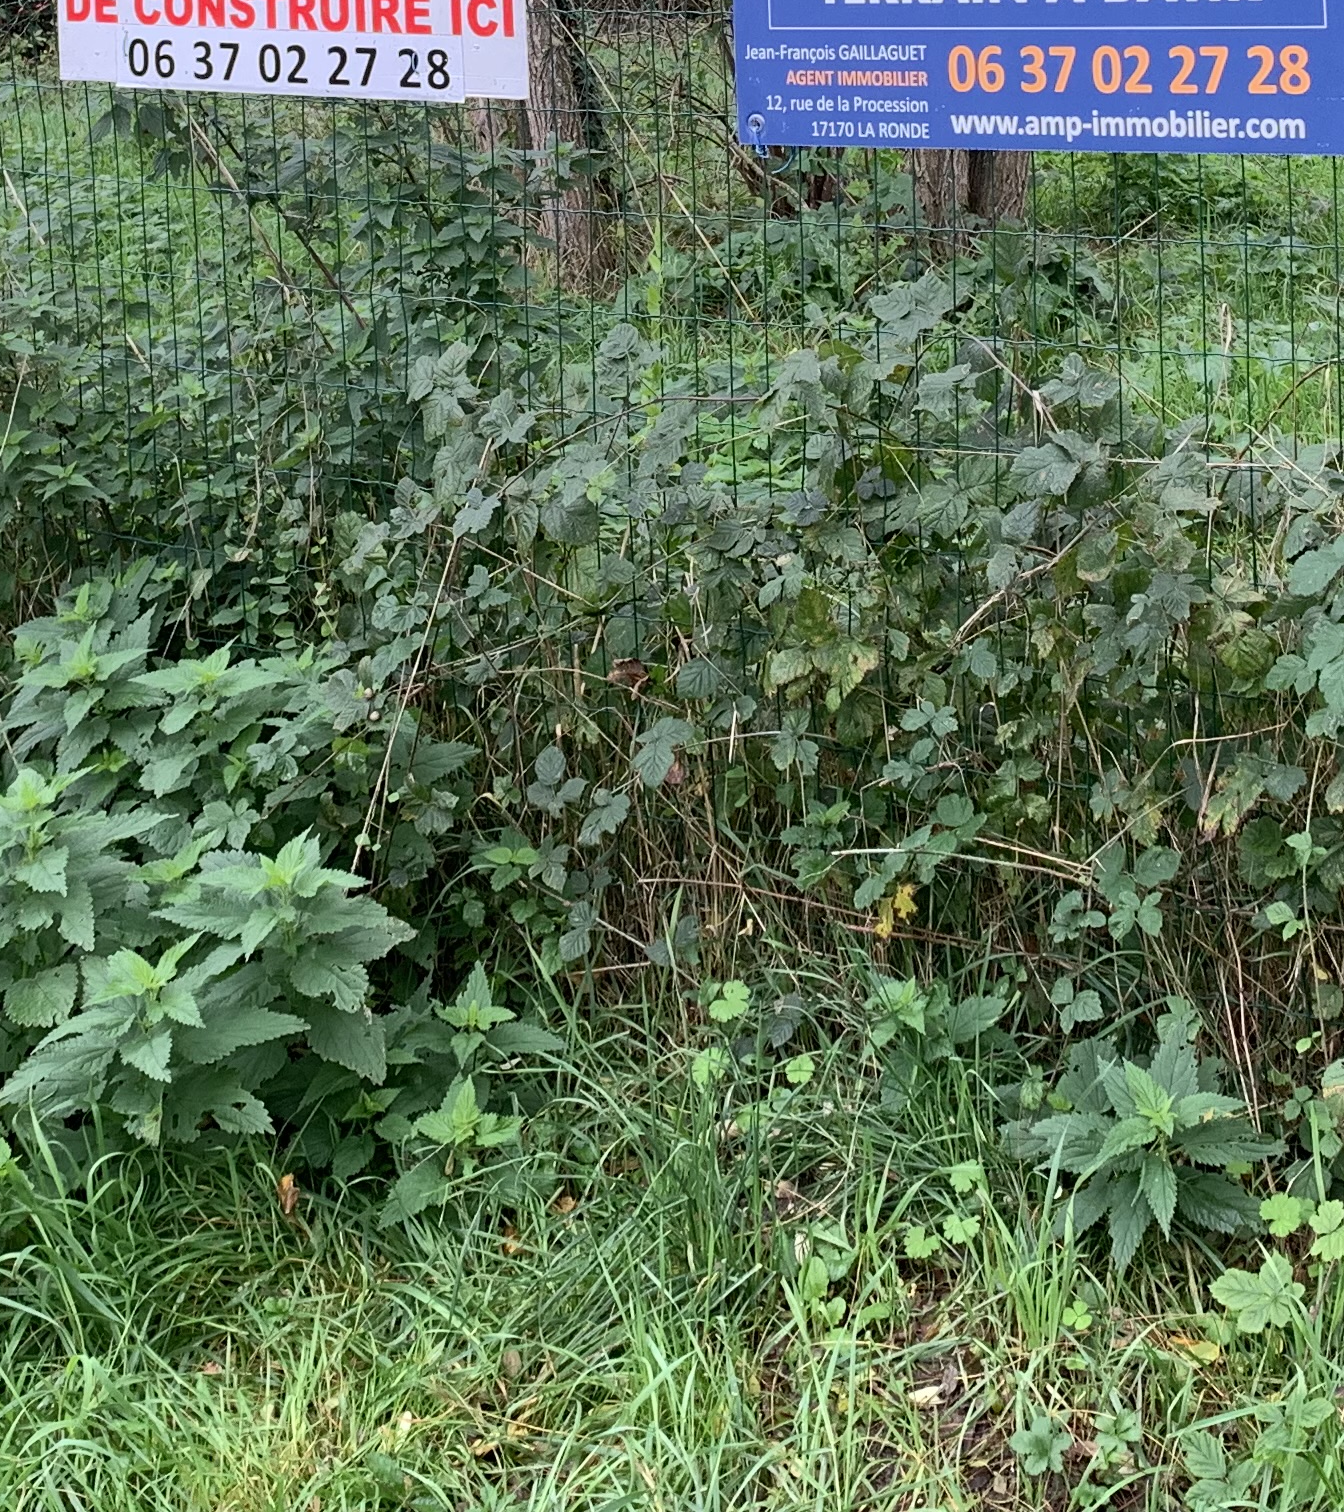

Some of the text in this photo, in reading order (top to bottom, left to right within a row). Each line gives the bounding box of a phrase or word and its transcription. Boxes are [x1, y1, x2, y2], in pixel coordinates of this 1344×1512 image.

[128, 38, 451, 90] 06 37 02 27 28
[744, 44, 927, 64] Jean-François GAILLAGUET
[785, 69, 928, 87] AGENT IMMOBILIER
[947, 44, 1311, 96] 06 37 02 27 28
[766, 94, 929, 114] 12, rue de la Procession
[811, 121, 930, 139] 17170 LA RONDE
[950, 109, 1307, 142] www.amp-immobilier.com
